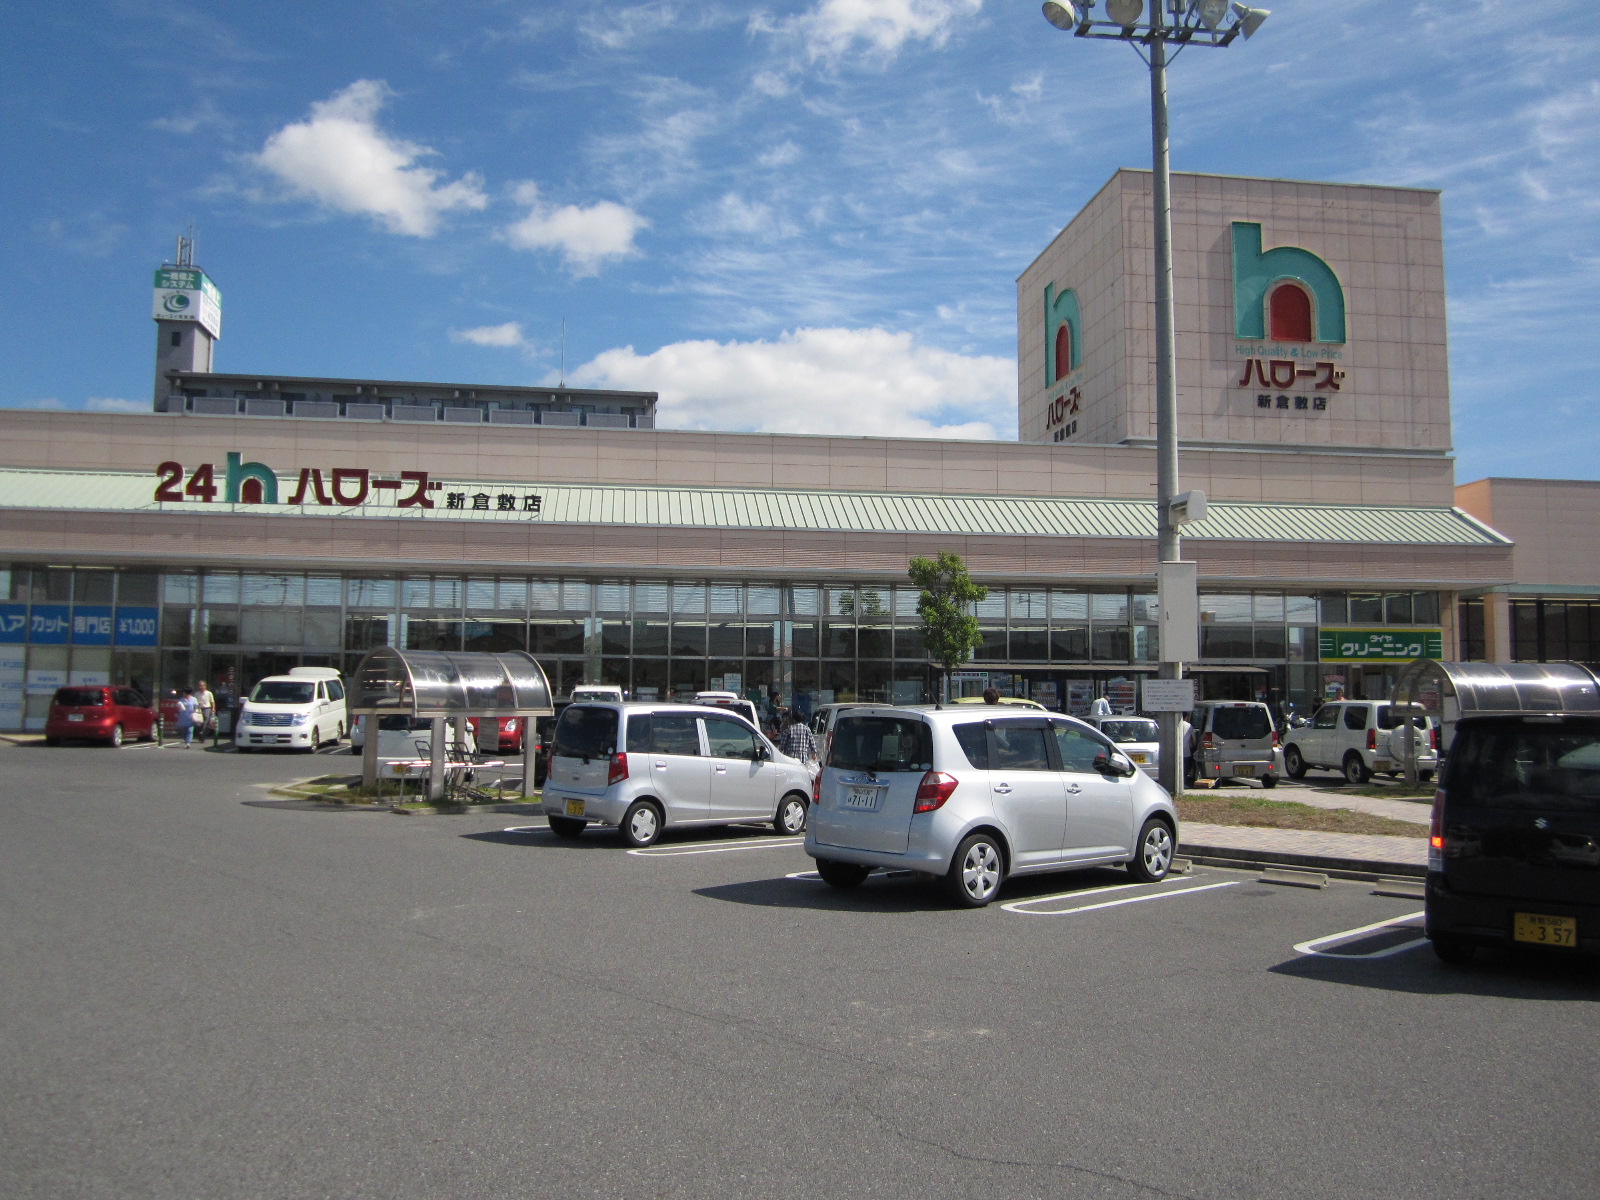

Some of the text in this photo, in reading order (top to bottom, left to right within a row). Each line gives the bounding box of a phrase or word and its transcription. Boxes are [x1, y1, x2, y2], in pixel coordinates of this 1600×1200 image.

[1235, 344, 1344, 359] High Quality & Low Price
[1239, 358, 1345, 390] ハローズ
[1046, 386, 1081, 430] ハローズ
[1257, 394, 1327, 411] 新倉敷店
[288, 467, 443, 510] ハローズ
[446, 492, 542, 513] 新倉敷店
